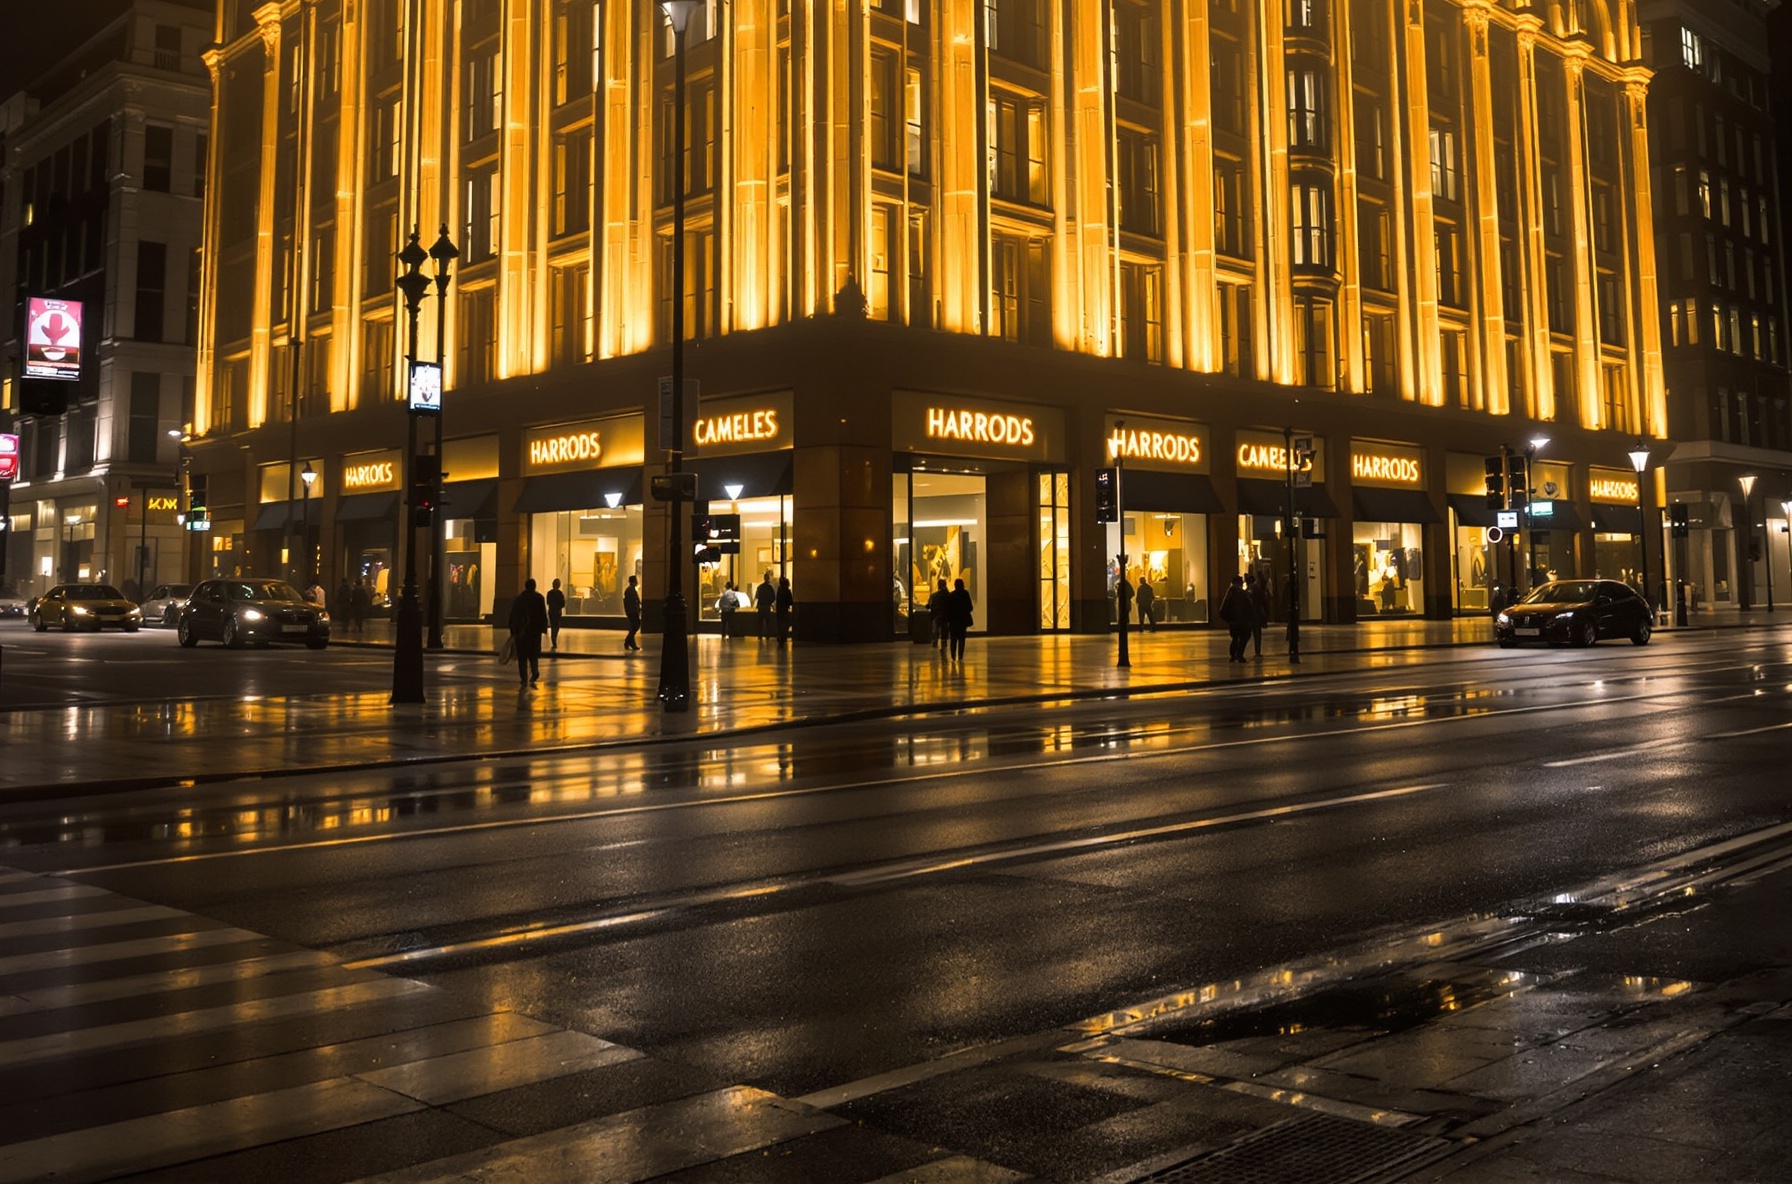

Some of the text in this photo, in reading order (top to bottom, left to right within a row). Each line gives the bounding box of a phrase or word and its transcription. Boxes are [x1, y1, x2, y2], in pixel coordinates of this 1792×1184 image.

[694, 410, 778, 444] CAMELES
[928, 407, 1034, 445] HARRODS
[531, 432, 601, 464] HARRODS
[1113, 428, 1200, 463] HARRODS
[1353, 454, 1419, 482] HARRODS
